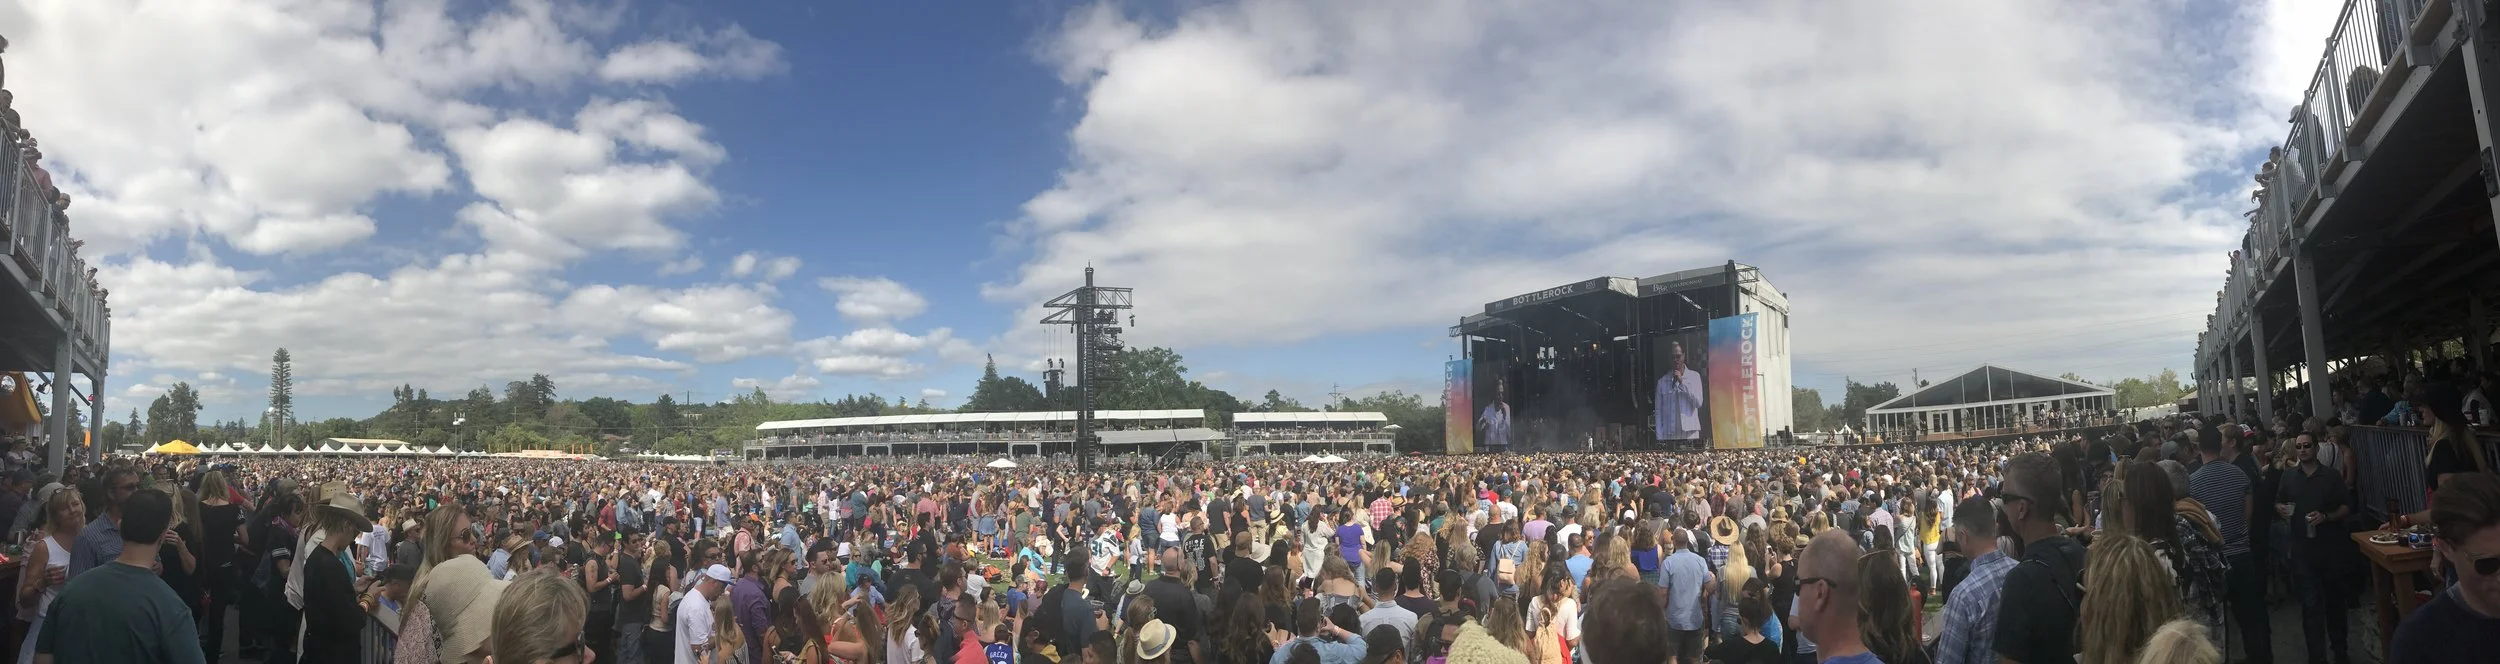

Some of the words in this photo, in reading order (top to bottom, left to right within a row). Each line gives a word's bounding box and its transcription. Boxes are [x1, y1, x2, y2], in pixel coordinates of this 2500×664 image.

[1512, 285, 1574, 306] BOTTLEROCK
[1741, 316, 1756, 443] BOTTLEROCK
[990, 651, 1008, 660] GREEN
